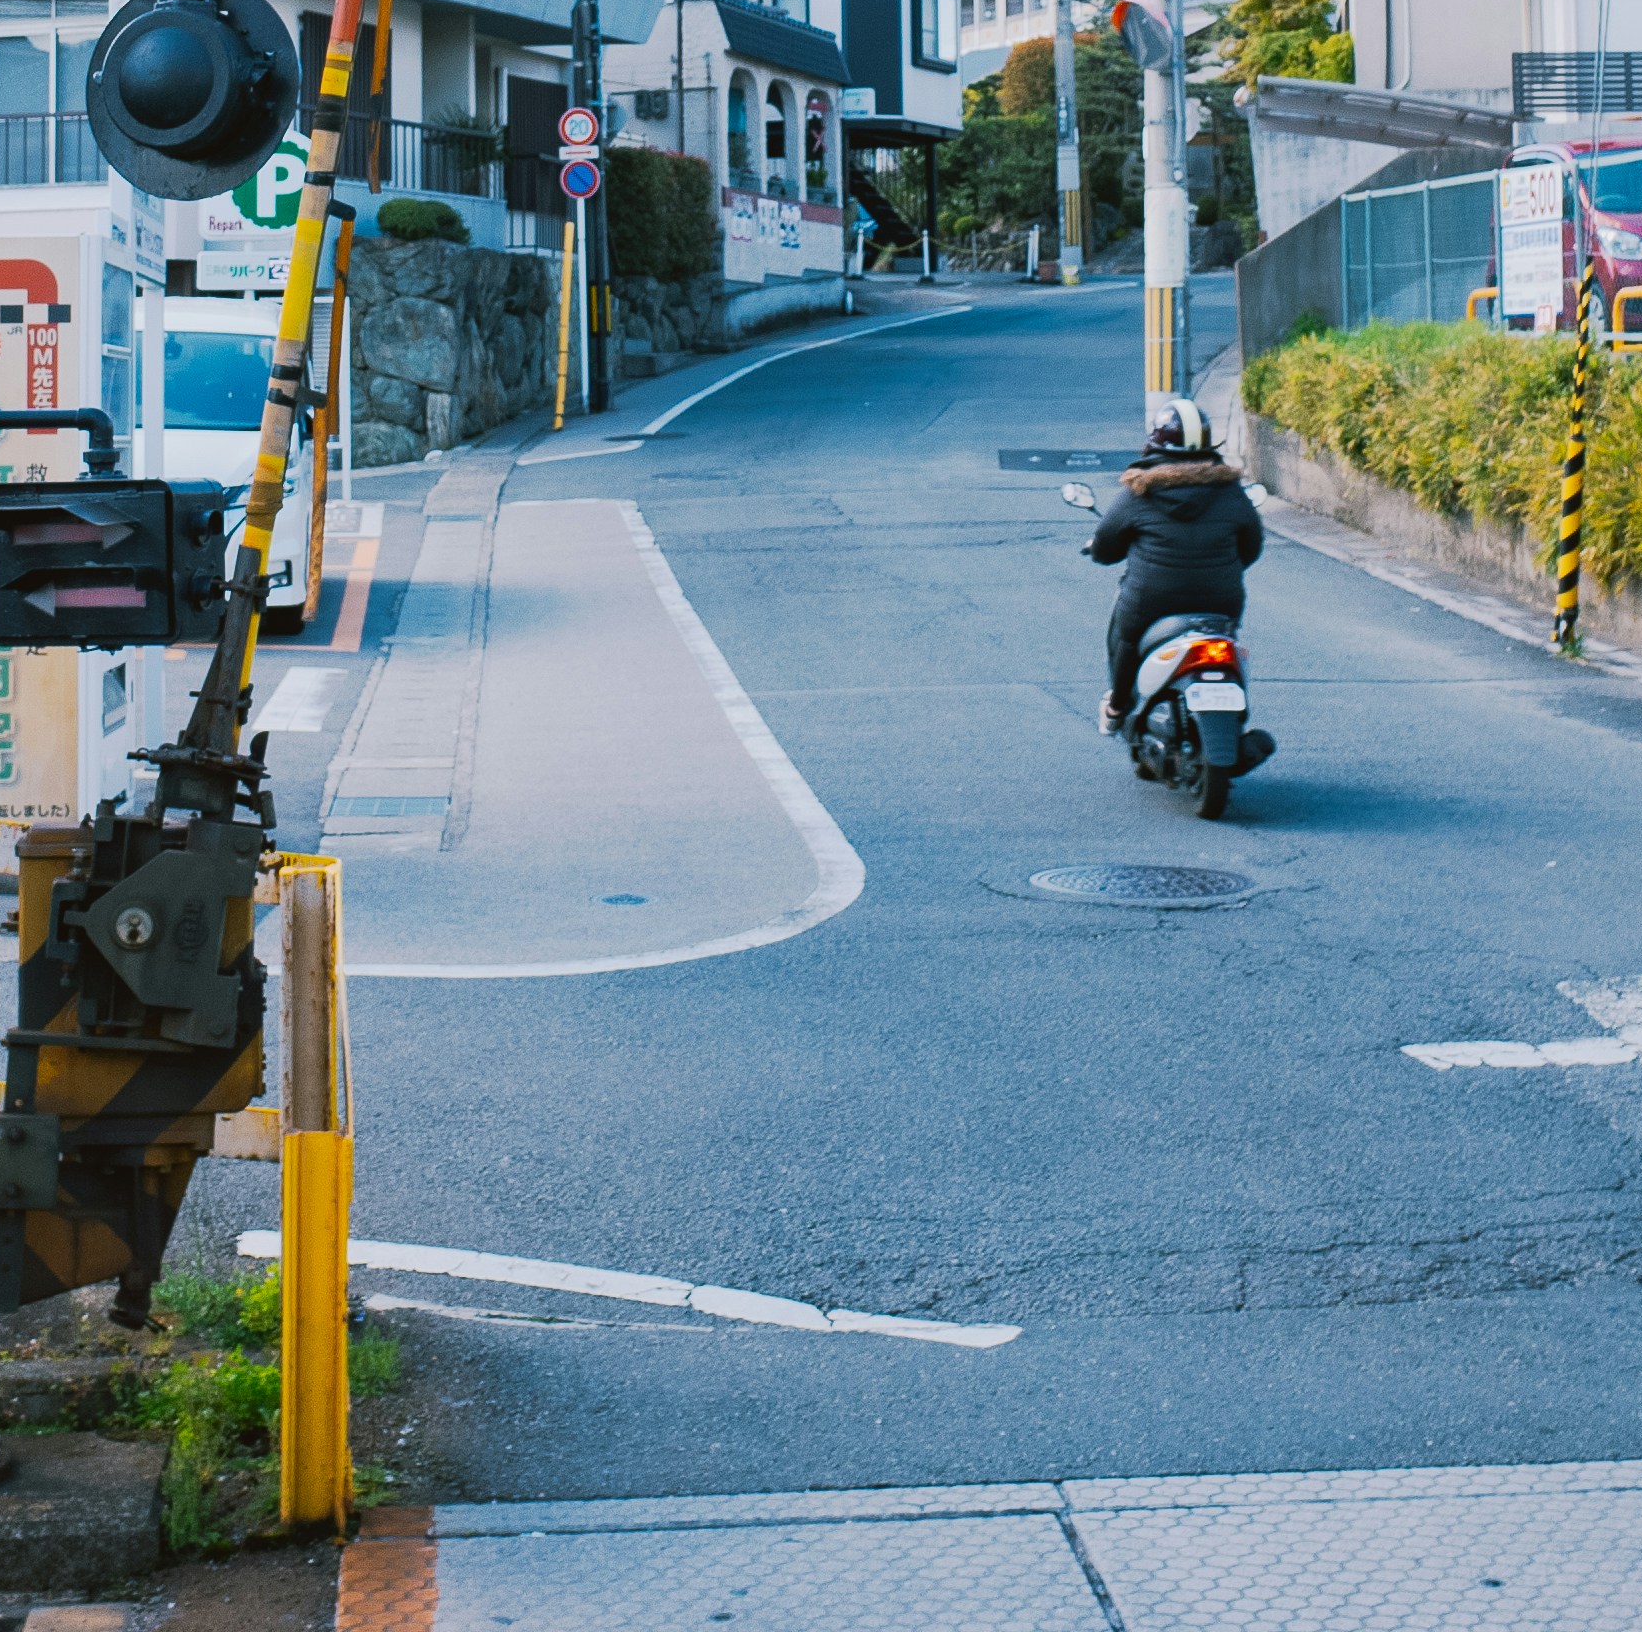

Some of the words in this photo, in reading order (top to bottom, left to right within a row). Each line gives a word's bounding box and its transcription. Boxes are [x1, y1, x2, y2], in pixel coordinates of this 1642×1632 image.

[256, 152, 308, 218] P
[208, 216, 243, 232] Repark
[7, 326, 23, 336] JR
[27, 327, 58, 410] 100M先左
